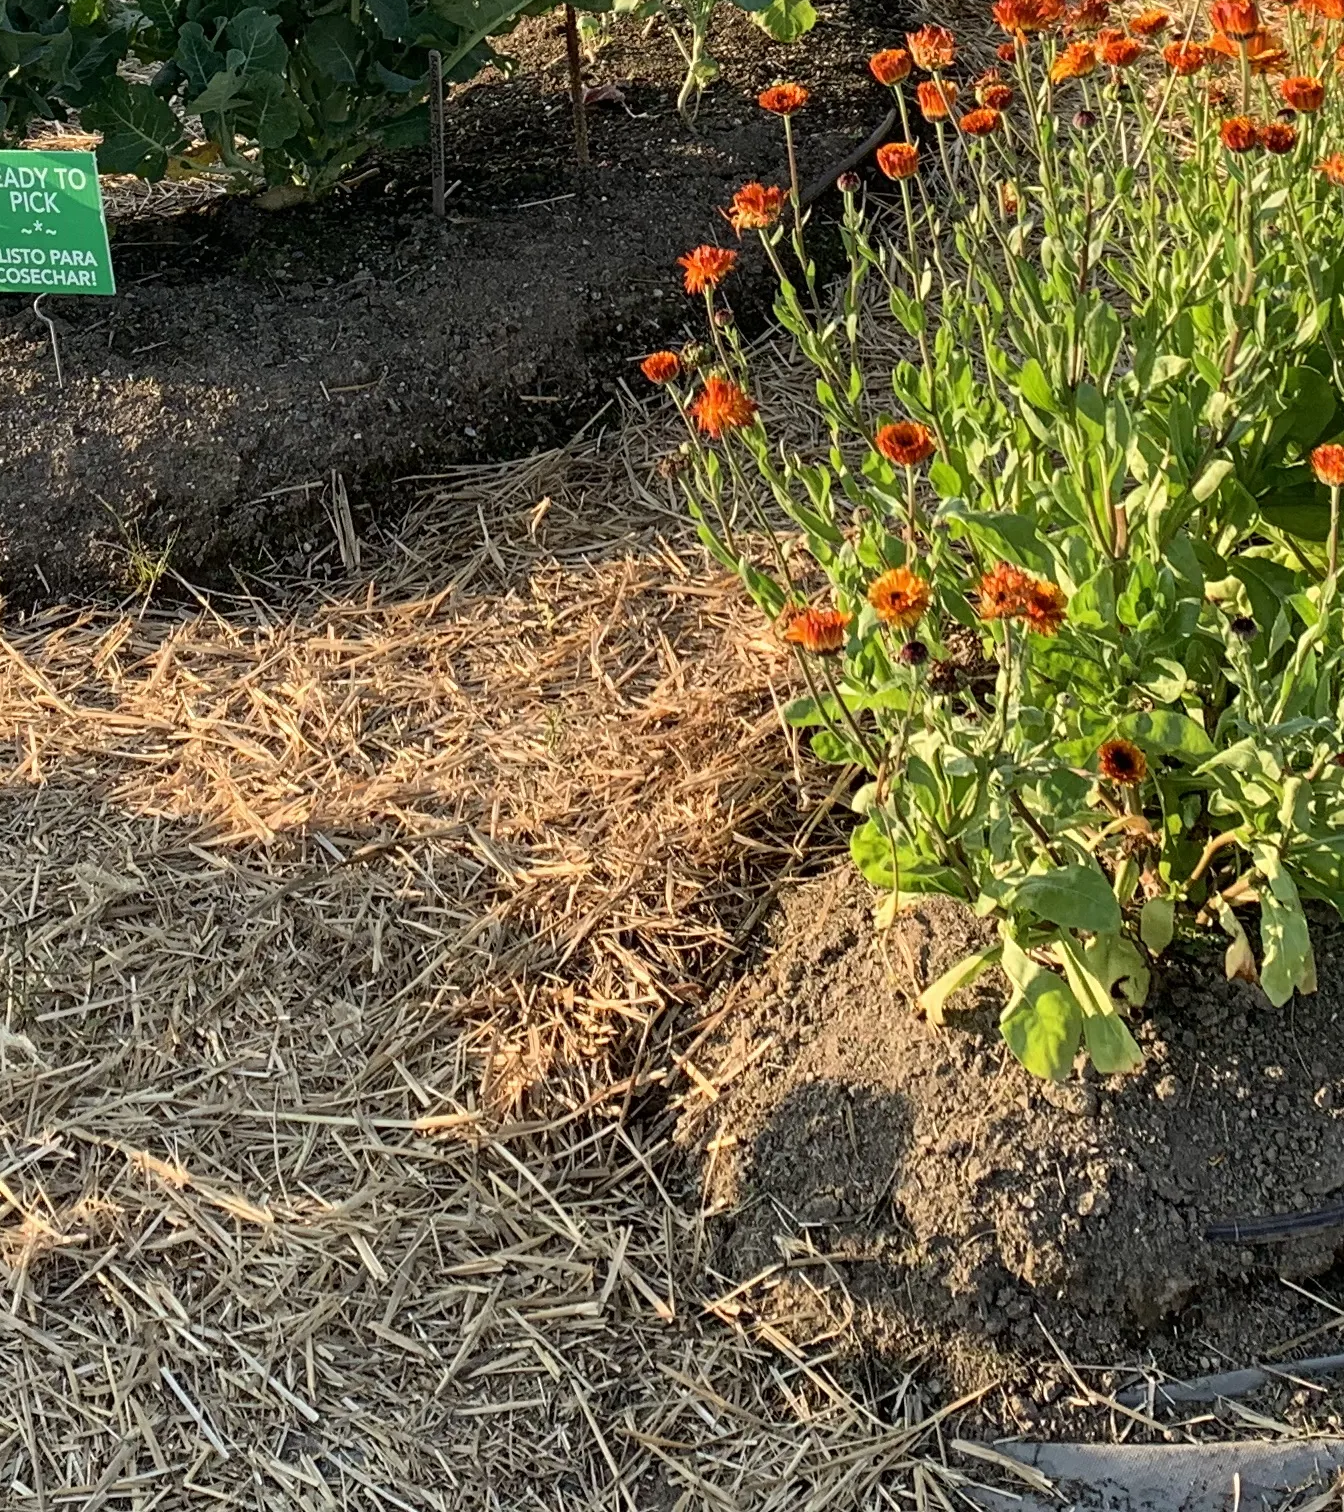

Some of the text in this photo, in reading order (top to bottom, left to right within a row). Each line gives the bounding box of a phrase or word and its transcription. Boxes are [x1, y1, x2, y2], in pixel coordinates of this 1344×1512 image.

[54, 167, 87, 190] TO
[9, 191, 61, 214] PICK
[49, 249, 98, 267] PARA
